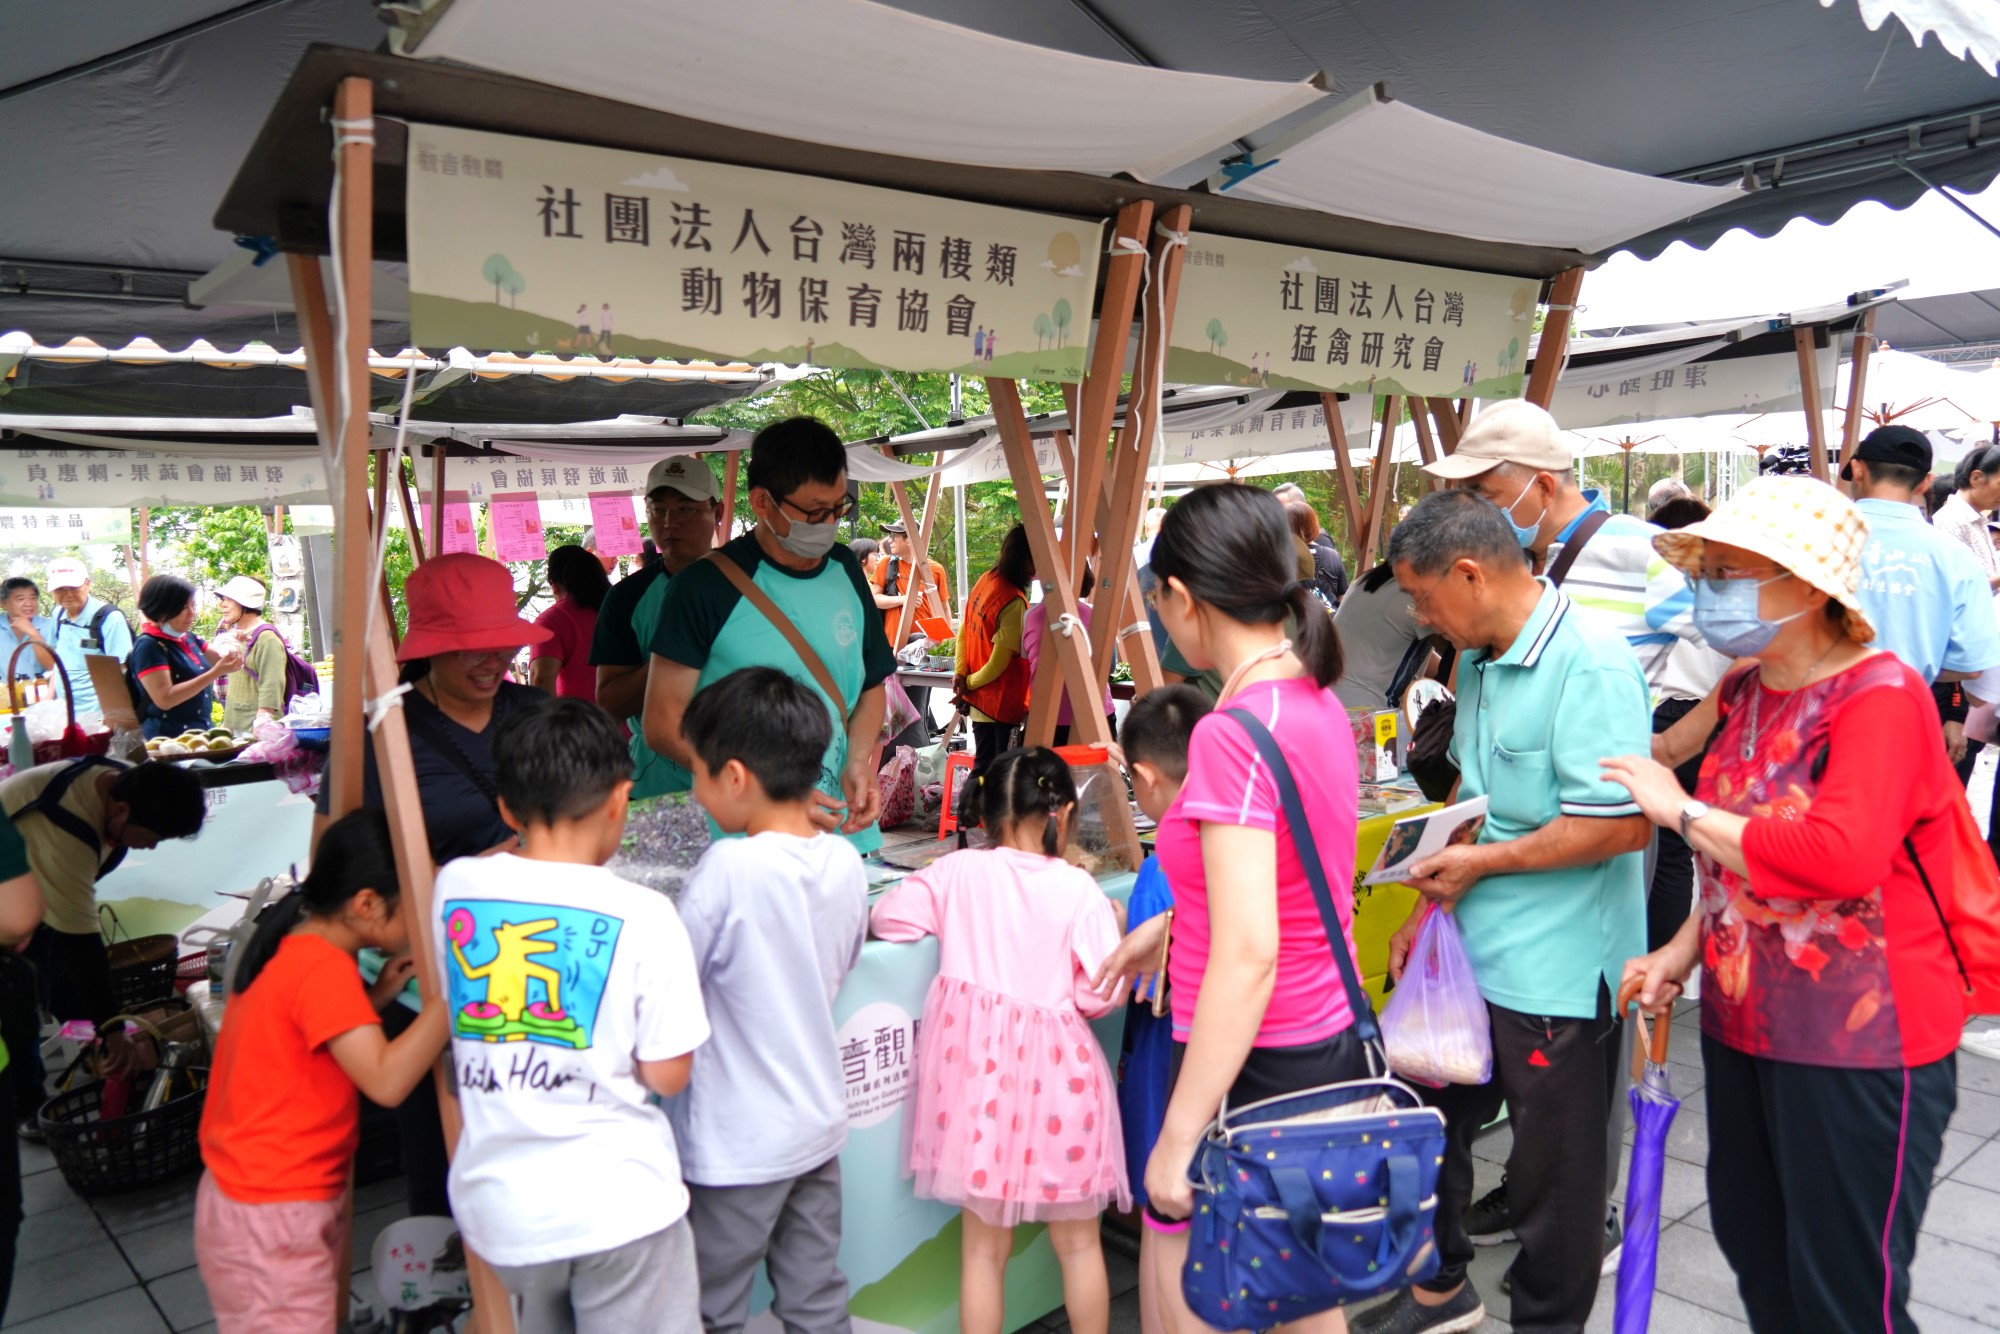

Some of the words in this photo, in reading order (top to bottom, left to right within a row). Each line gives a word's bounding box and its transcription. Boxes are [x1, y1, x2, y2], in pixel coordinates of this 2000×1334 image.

[536, 184, 1018, 287] 社團法人台灣兩棲類
[681, 266, 977, 338] 動物保育協會
[1280, 271, 1464, 327] 社團法人台灣
[1291, 323, 1445, 372] 猛禽研究會
